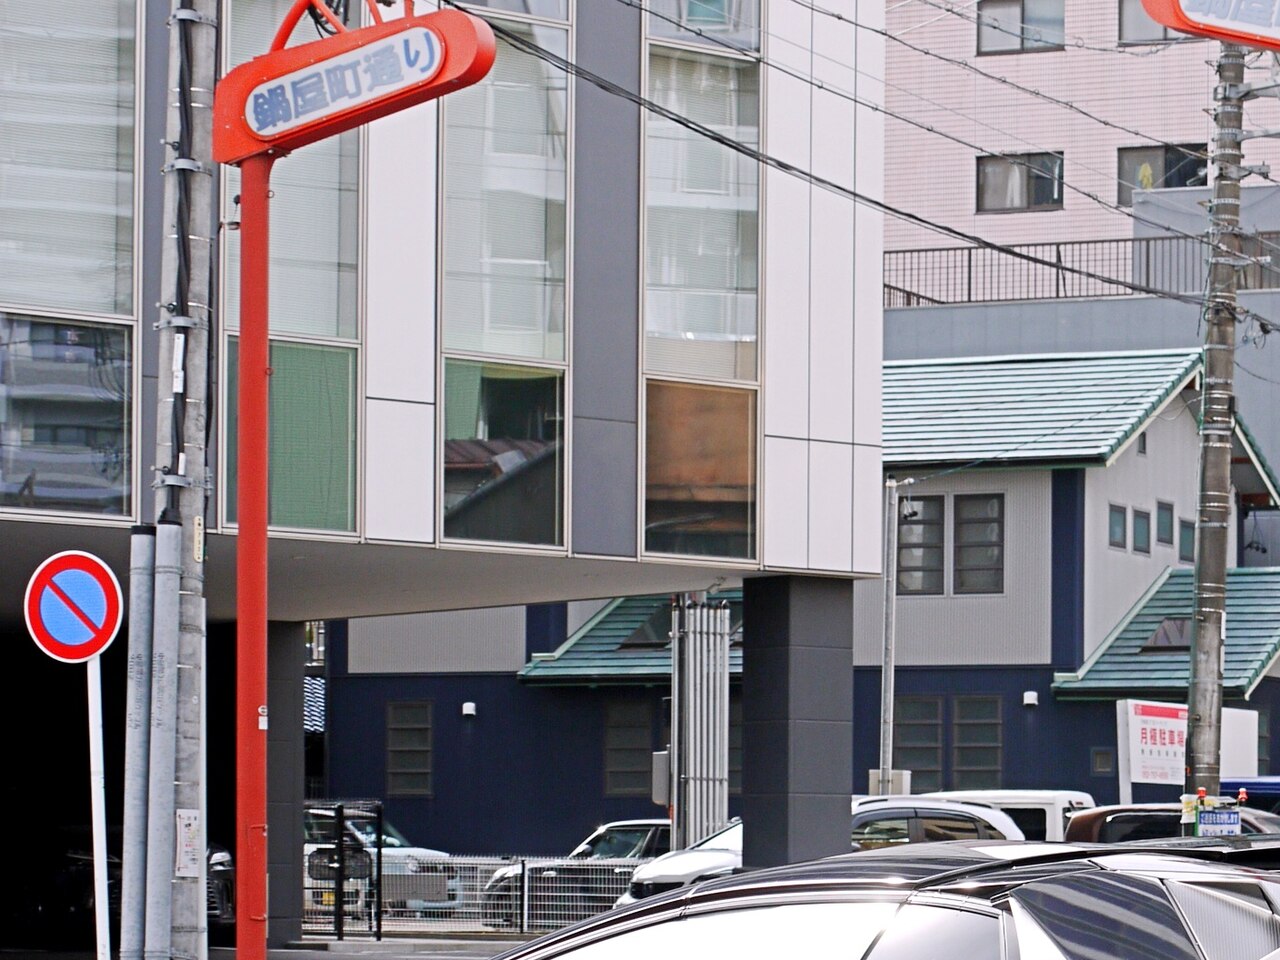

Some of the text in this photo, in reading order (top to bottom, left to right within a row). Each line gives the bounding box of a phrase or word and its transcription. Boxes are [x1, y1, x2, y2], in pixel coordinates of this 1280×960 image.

[253, 32, 435, 131] 鍋屋町通り
